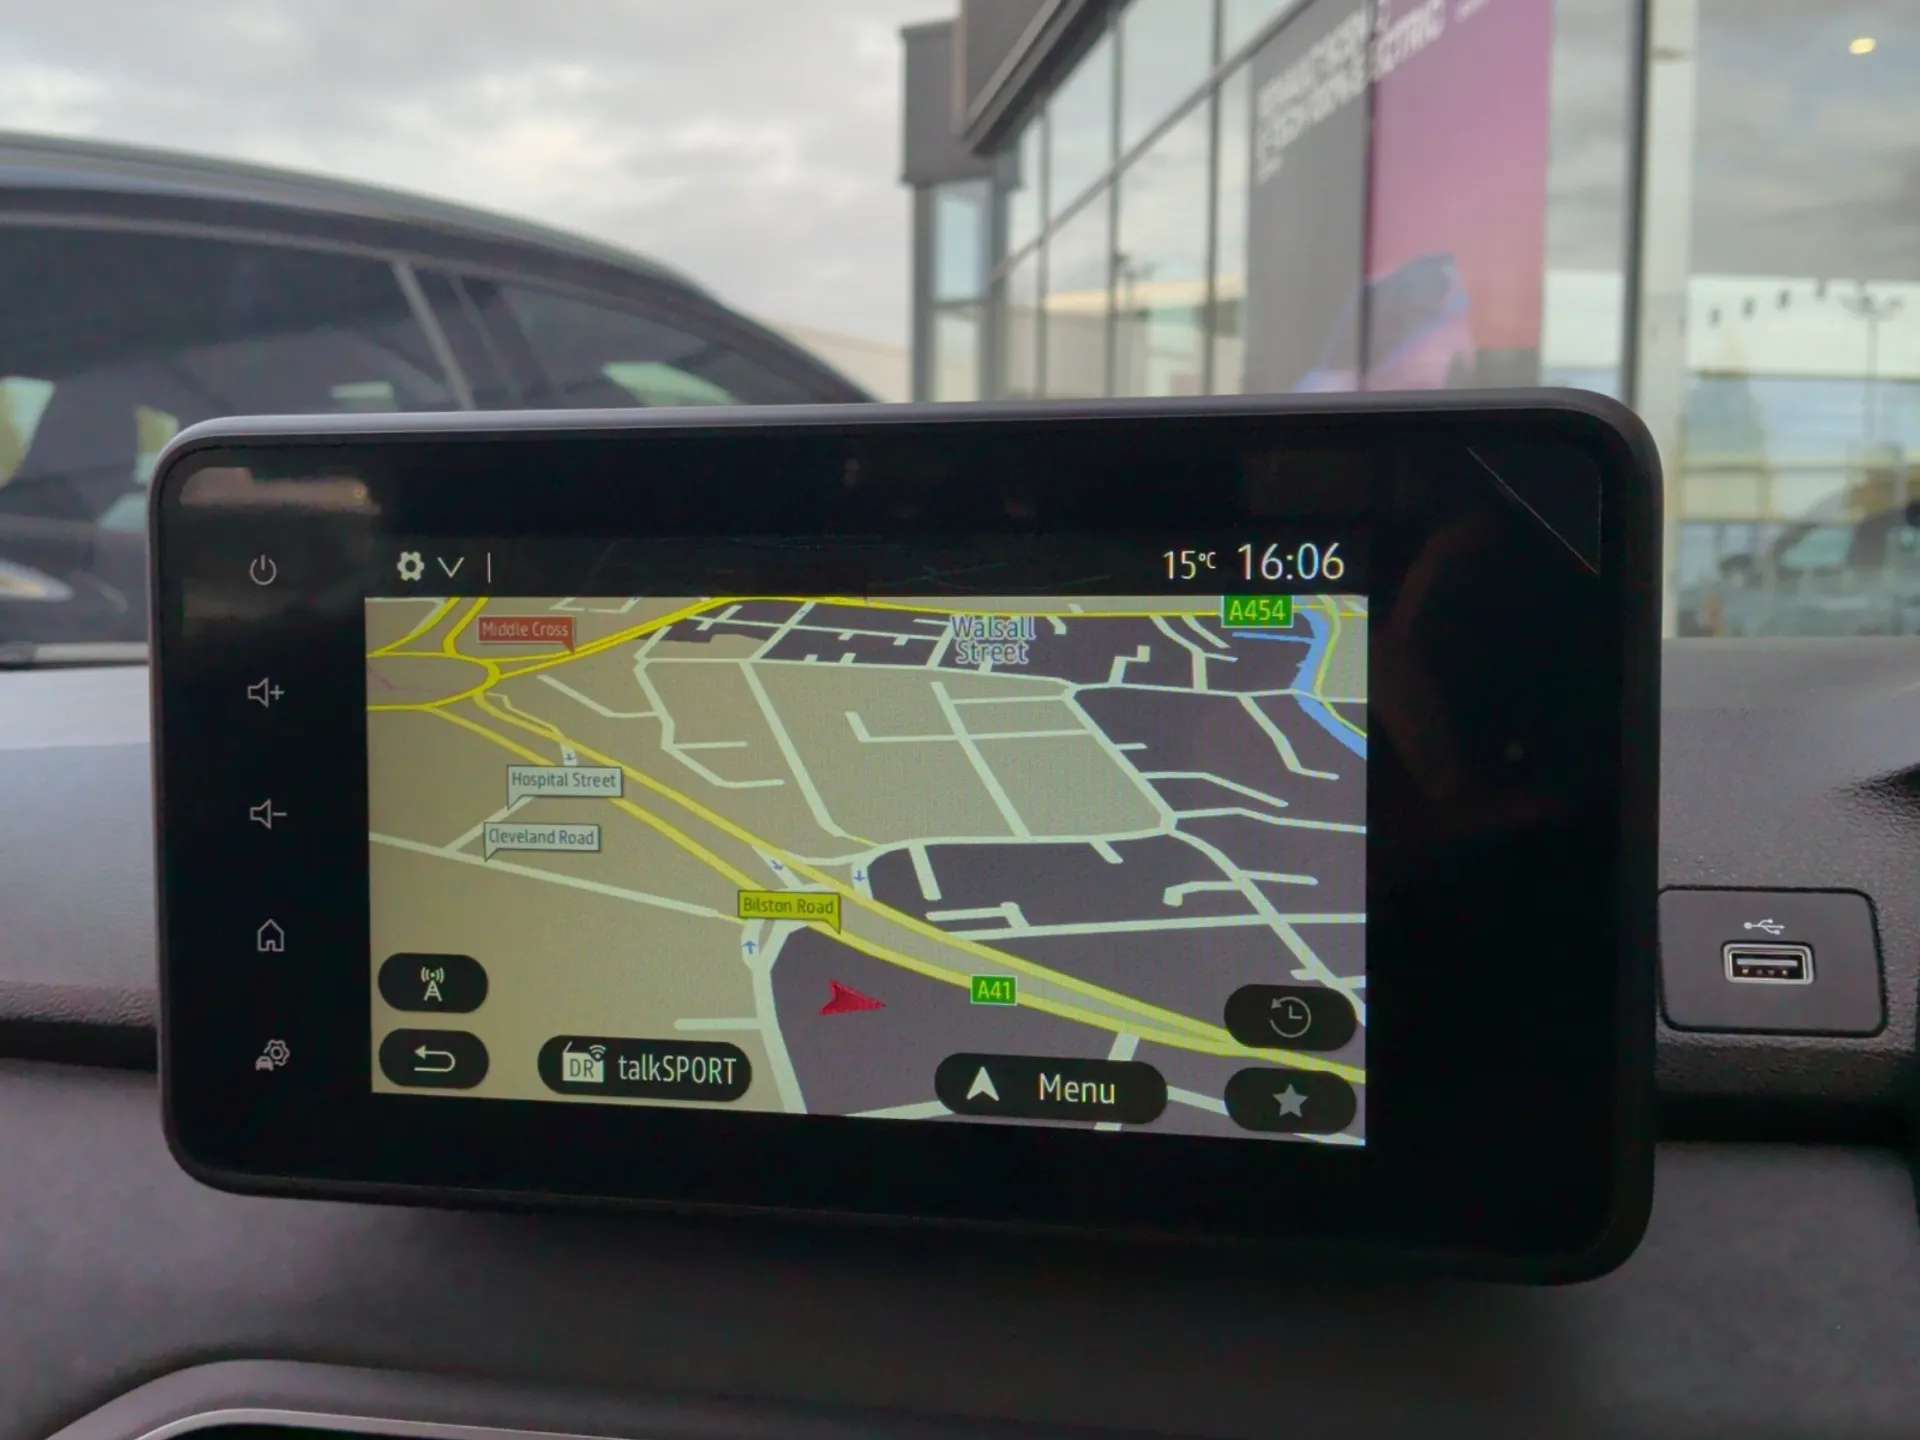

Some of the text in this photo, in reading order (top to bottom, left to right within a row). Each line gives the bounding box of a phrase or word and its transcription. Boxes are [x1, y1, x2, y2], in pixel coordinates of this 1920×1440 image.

[1237, 542, 1345, 580] 16:06
[1229, 599, 1286, 621] A454
[481, 621, 569, 637] Middle Cross
[950, 615, 1036, 640] Walsall
[955, 640, 1029, 664] Street
[511, 772, 617, 789] Hospital Street
[488, 827, 595, 846] Cleveland Road
[743, 896, 834, 914] Bilston Road
[977, 979, 1011, 1000] A41
[569, 1053, 737, 1085] DR talkSPORT
[1039, 1072, 1115, 1105] Menu
